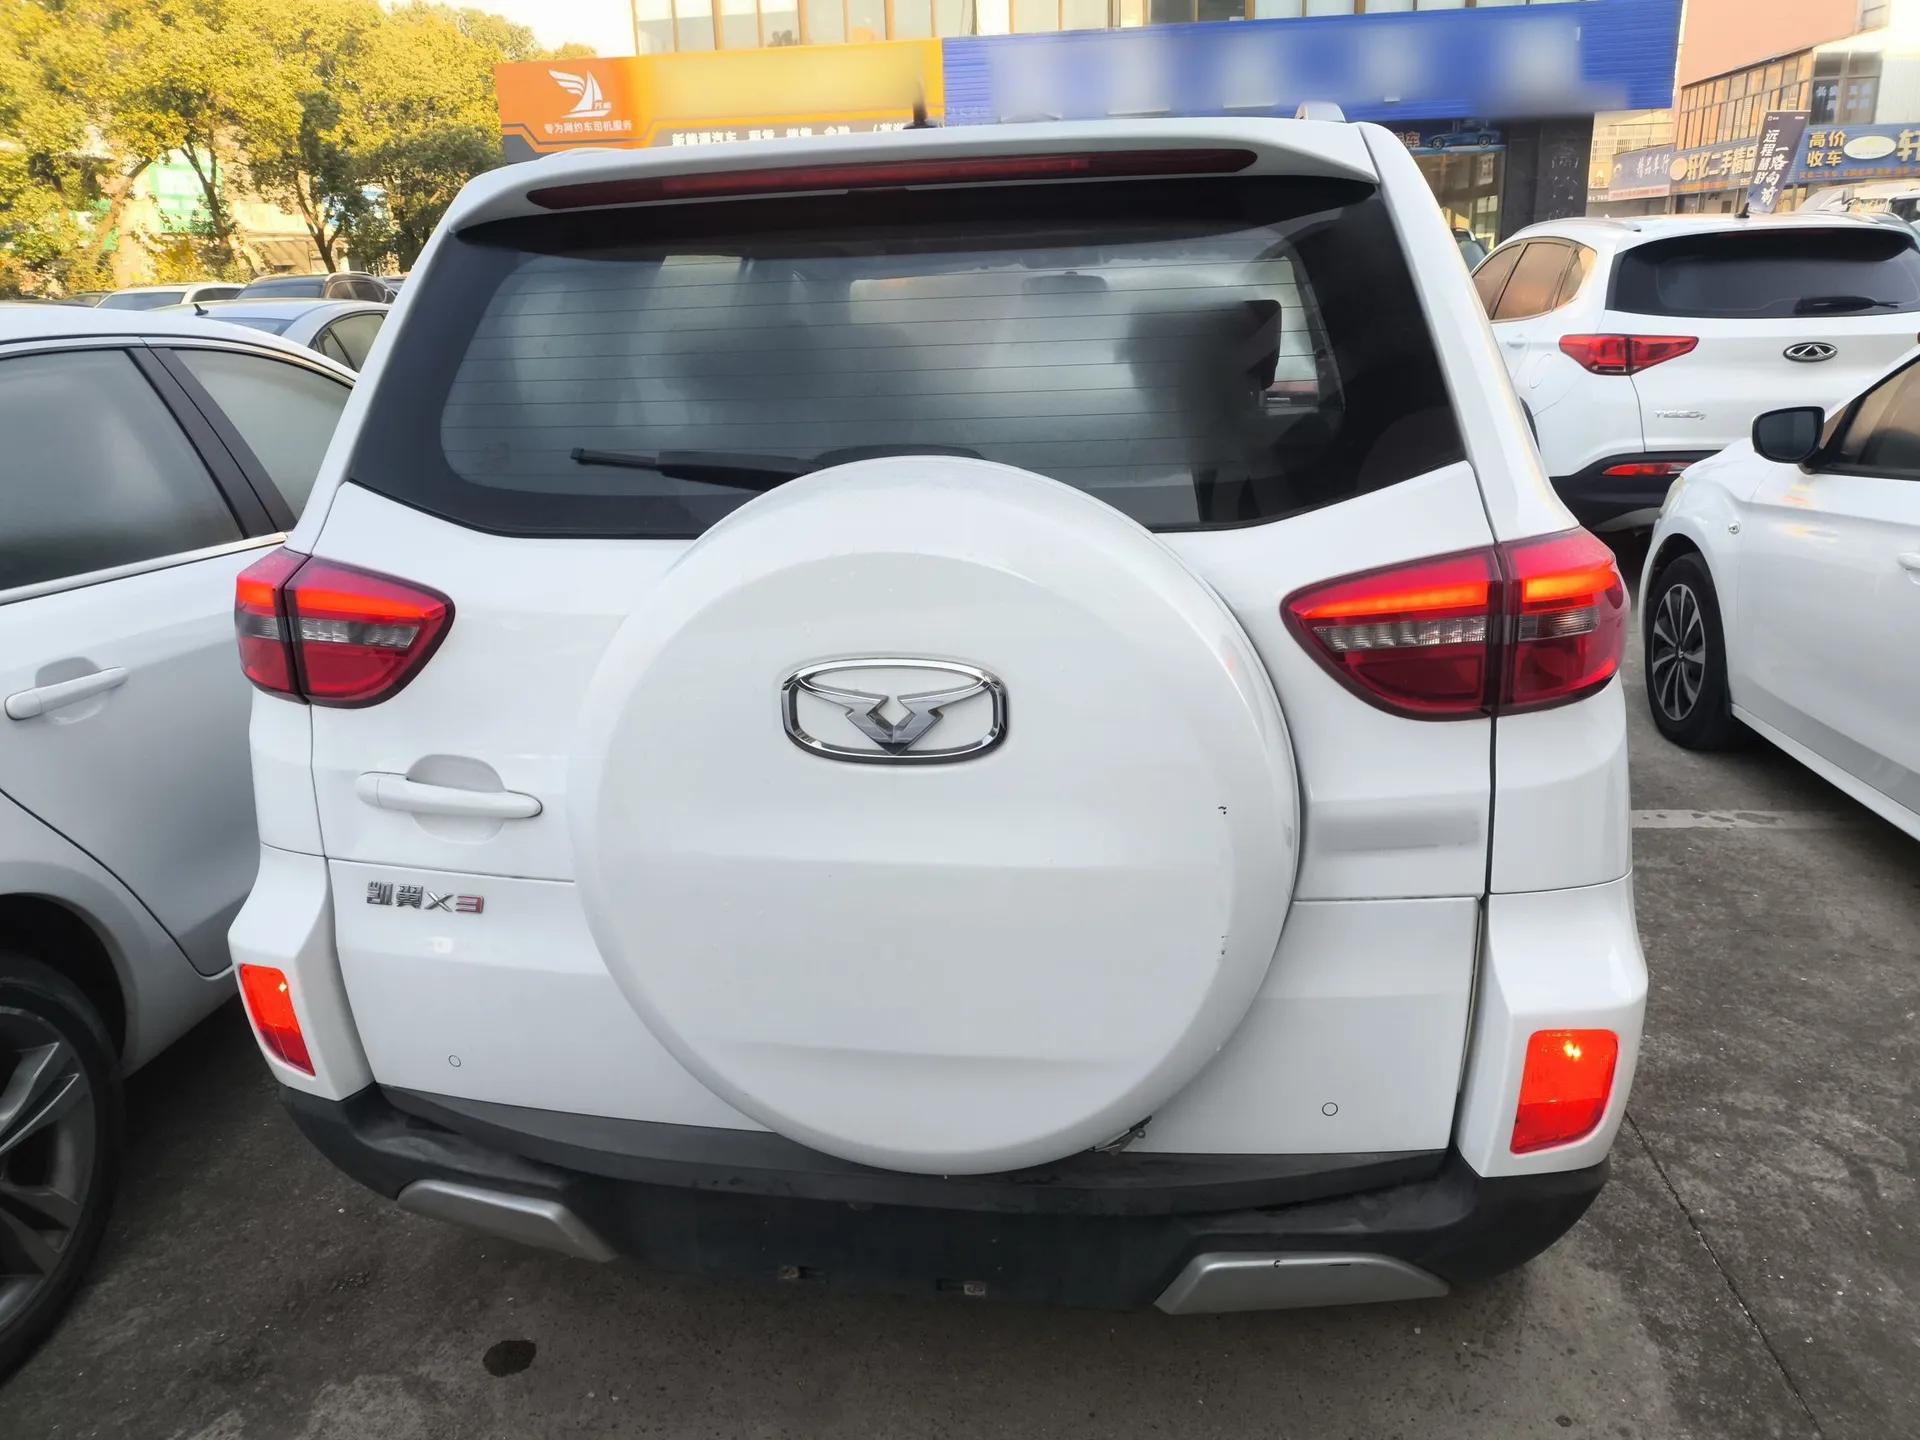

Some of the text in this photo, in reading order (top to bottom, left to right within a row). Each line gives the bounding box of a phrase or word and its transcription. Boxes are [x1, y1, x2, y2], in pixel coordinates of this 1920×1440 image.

[1808, 130, 1847, 148] 高价
[1806, 150, 1843, 168] 收车
[366, 881, 485, 914] 凯翼X3
